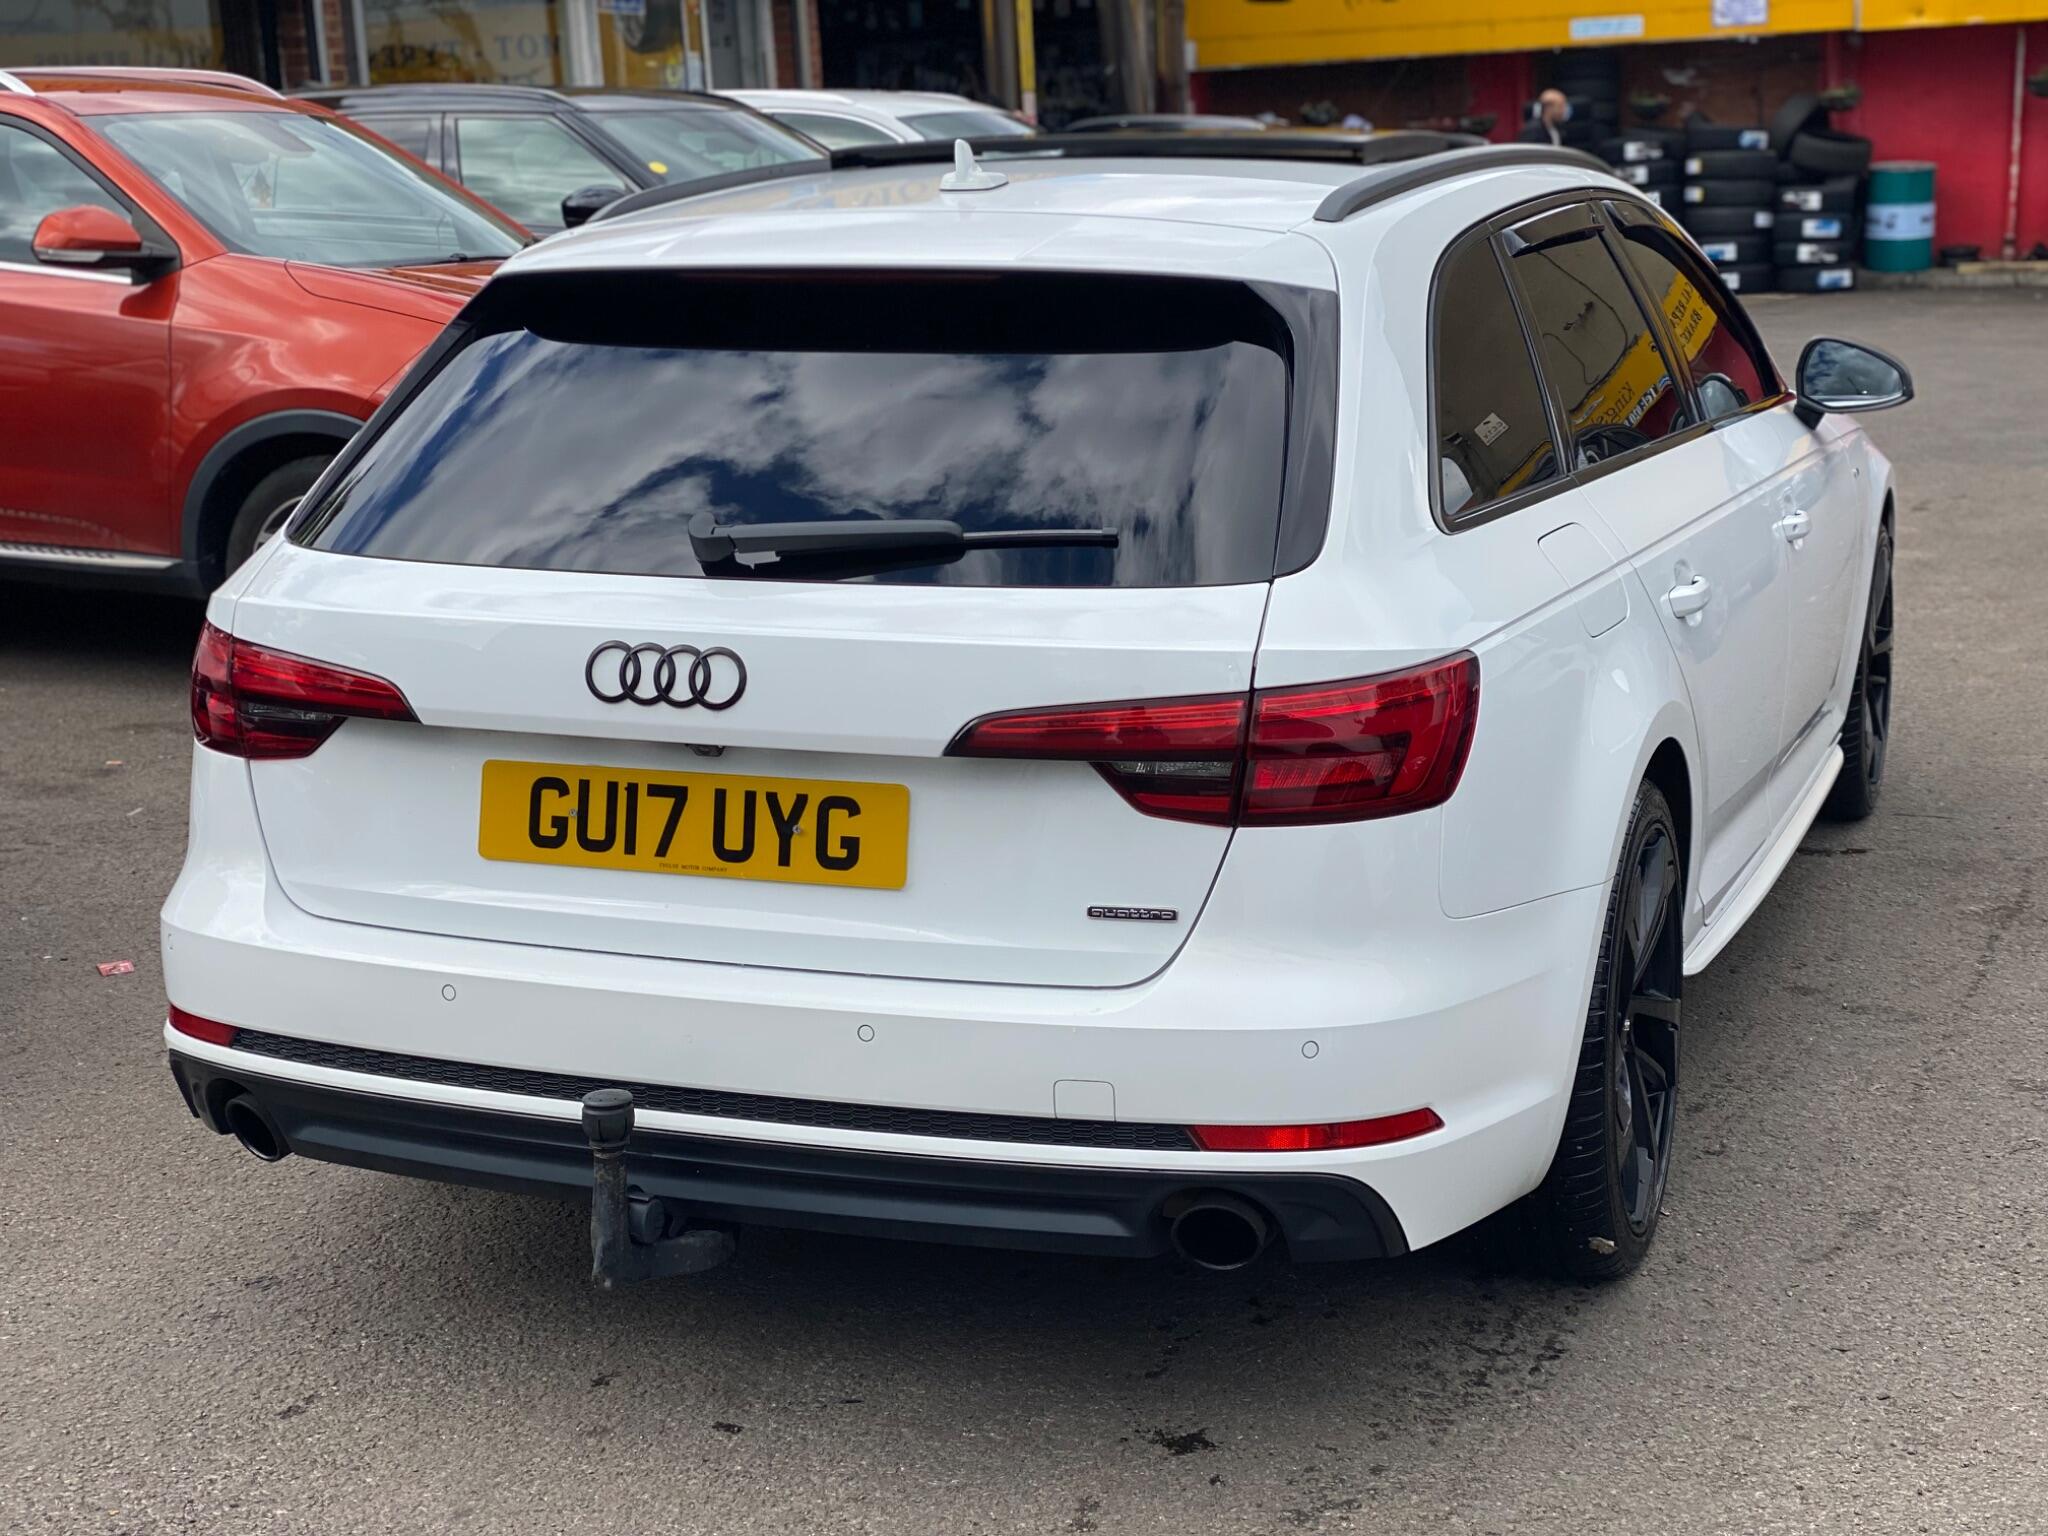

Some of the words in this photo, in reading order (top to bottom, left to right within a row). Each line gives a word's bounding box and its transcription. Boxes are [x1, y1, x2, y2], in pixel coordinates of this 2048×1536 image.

[528, 776, 689, 857] GU17
[712, 787, 862, 871] UYG
[1091, 908, 1175, 919] quattro
